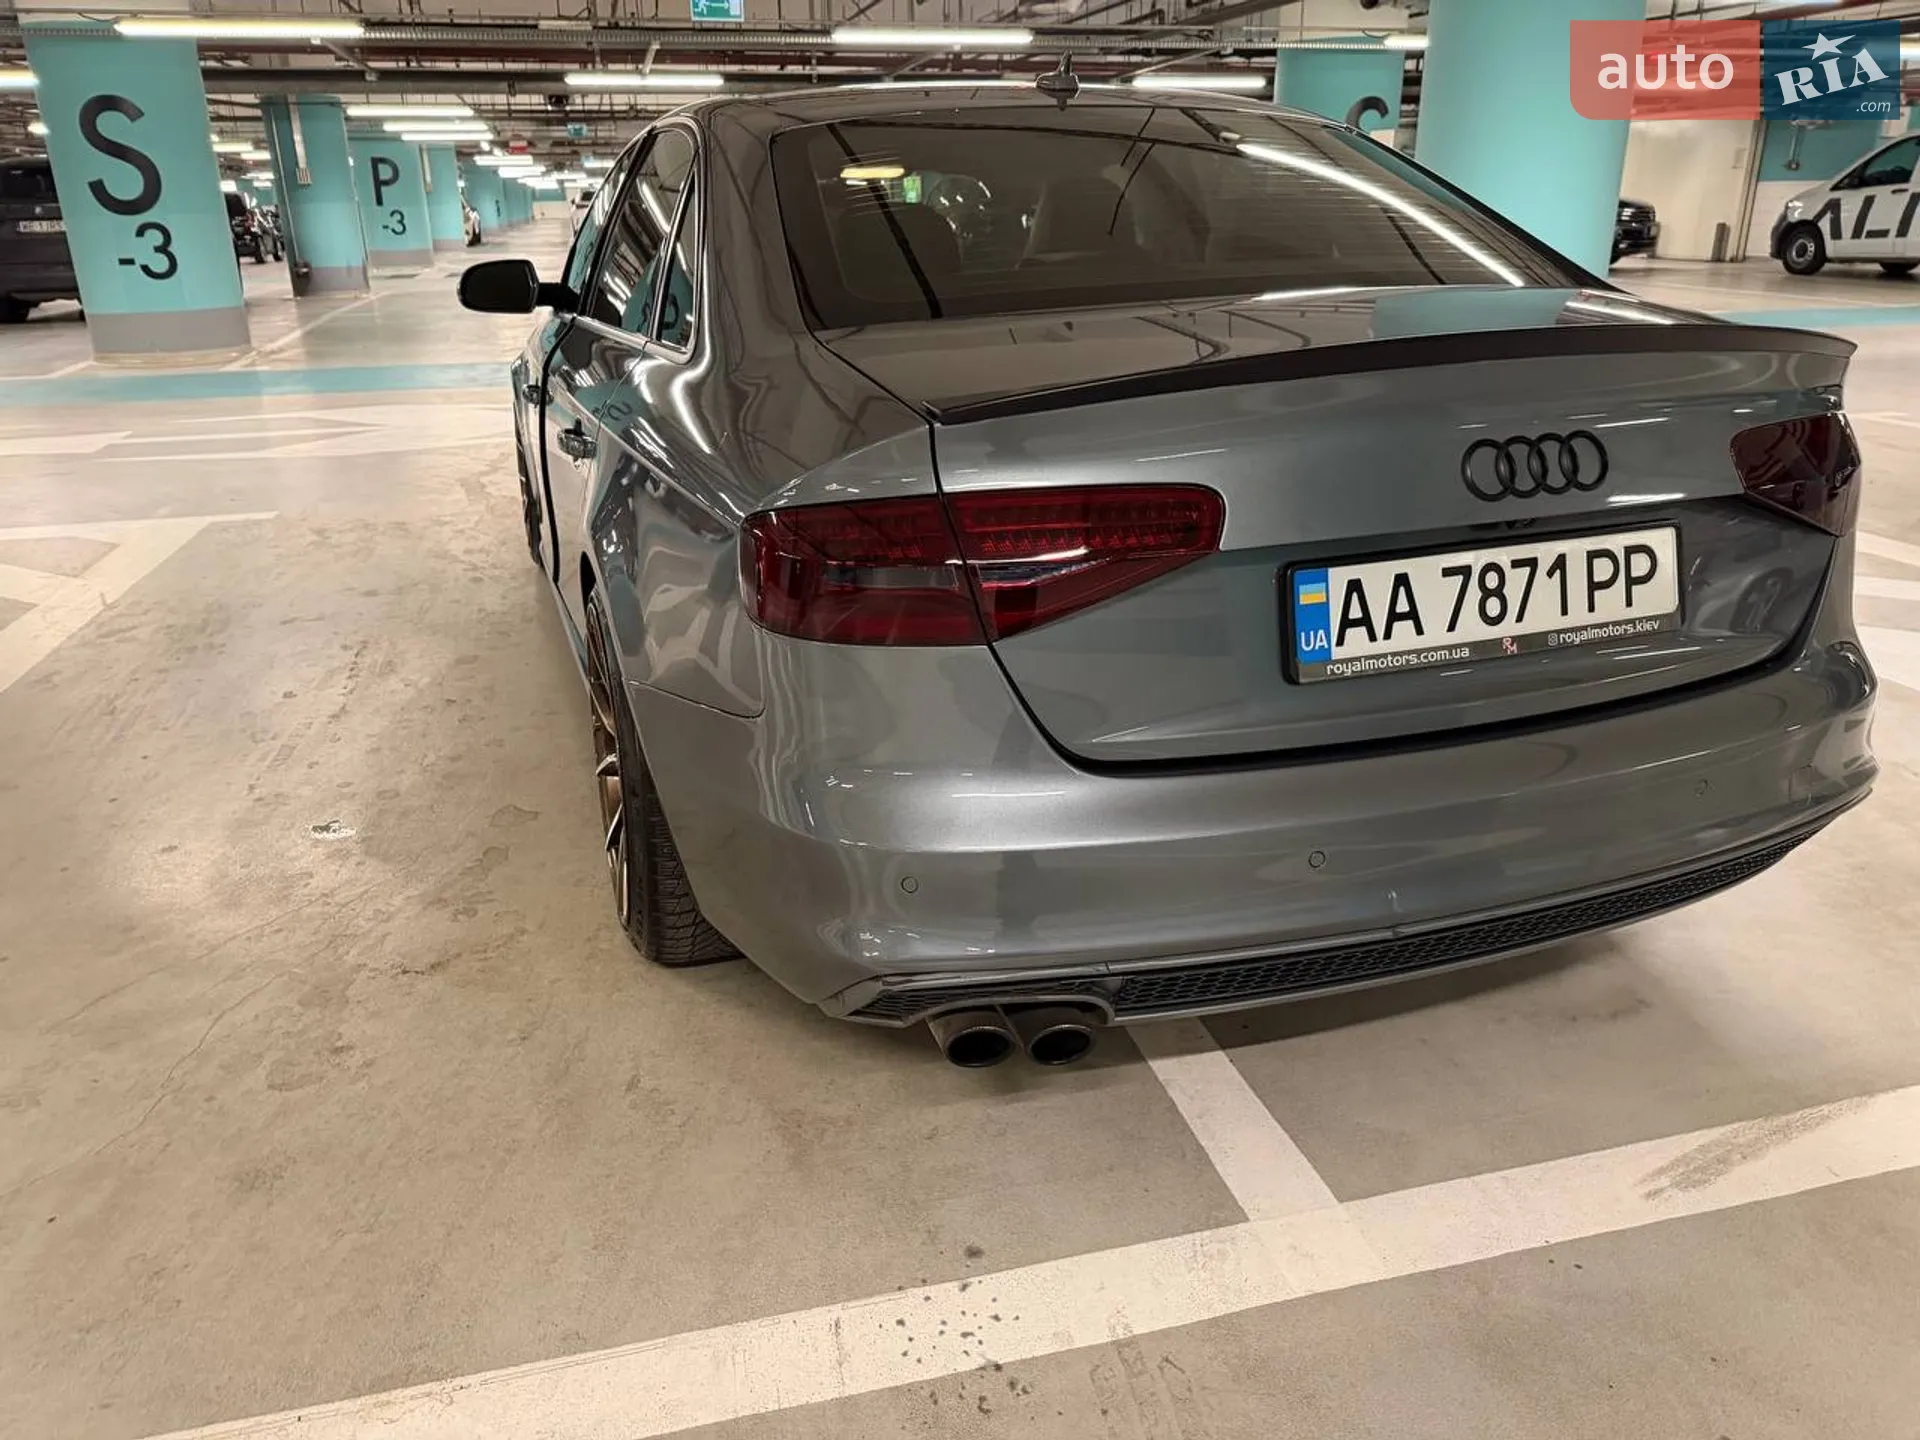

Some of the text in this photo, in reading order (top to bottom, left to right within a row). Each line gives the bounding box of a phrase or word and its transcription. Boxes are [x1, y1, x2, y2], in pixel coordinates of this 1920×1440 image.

[79, 94, 163, 216] S
[371, 156, 399, 206] P
[382, 209, 406, 235] -3
[118, 222, 178, 280] -3
[1335, 544, 1658, 646] AA 7871 PP
[1301, 629, 1328, 652] UA
[1327, 647, 1470, 676] royalmotors.com.ua
